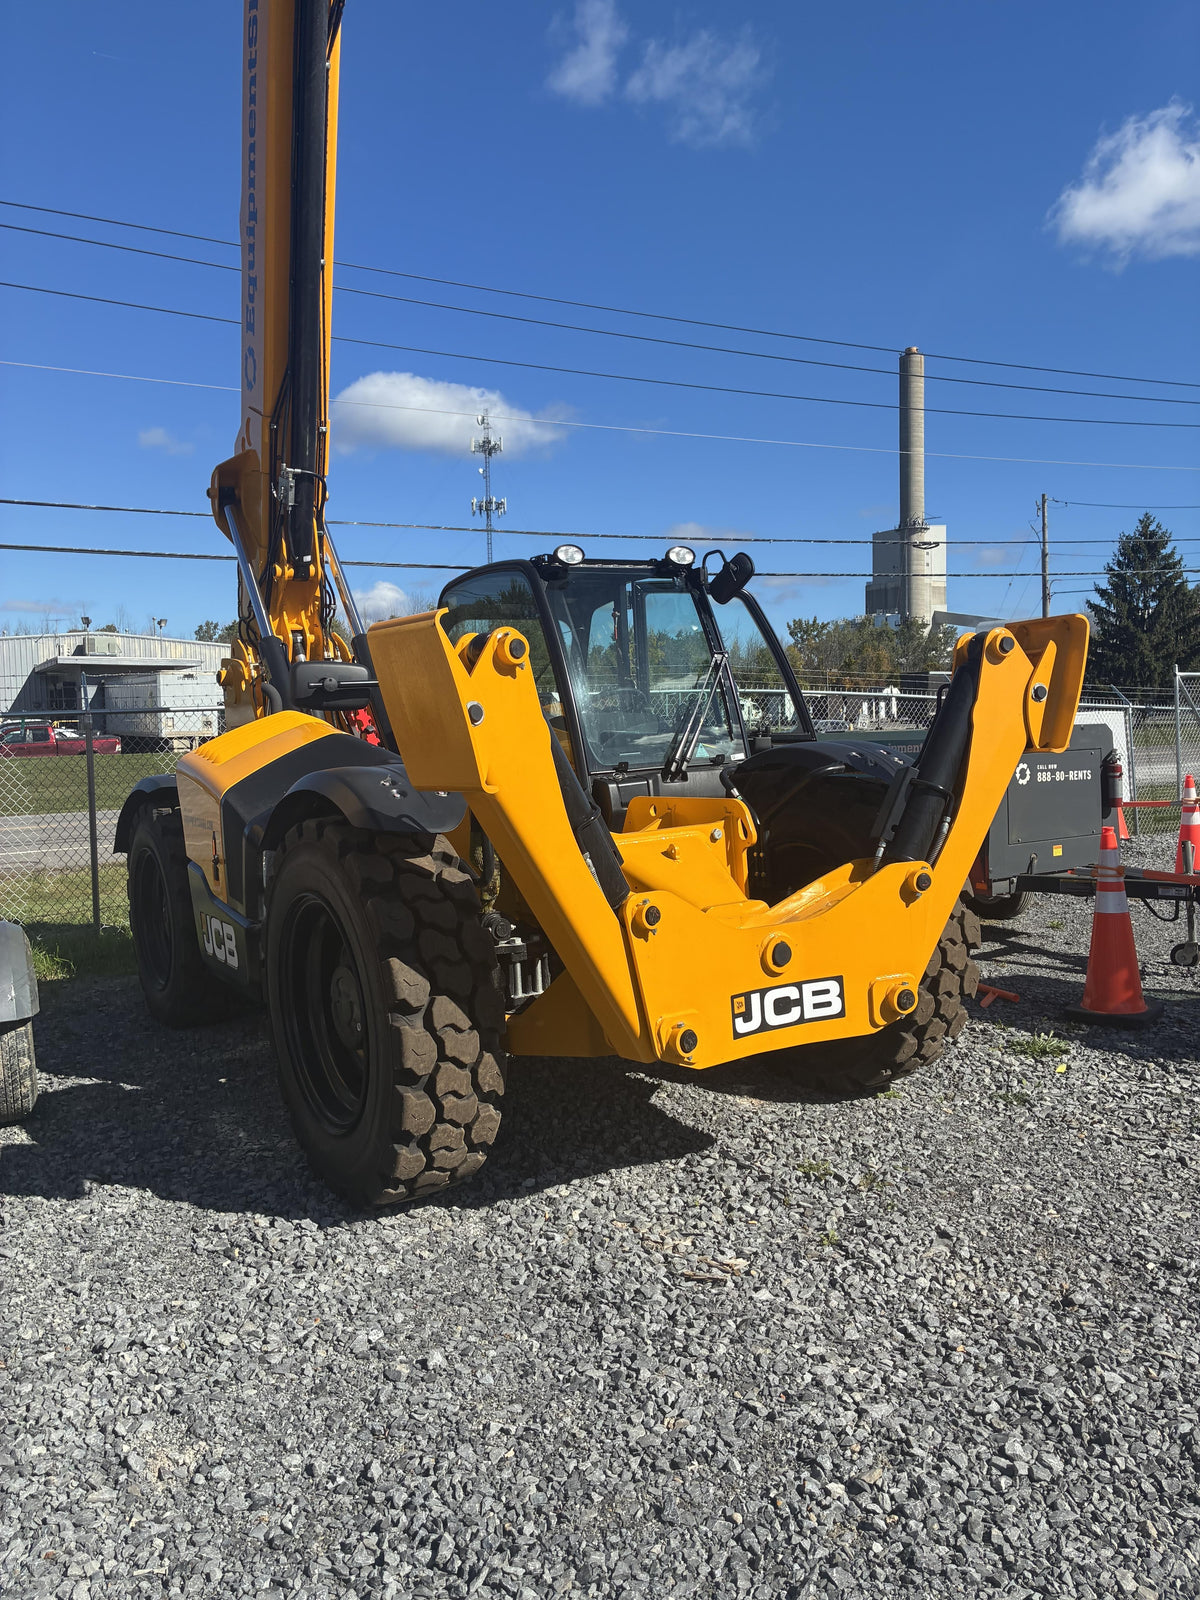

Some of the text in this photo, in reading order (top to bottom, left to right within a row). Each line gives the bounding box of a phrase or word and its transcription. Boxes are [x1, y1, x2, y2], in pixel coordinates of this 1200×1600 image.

[1037, 770, 1092, 782] 888-80-RENTS
[203, 914, 239, 969] JCB
[734, 979, 843, 1034] JCB
